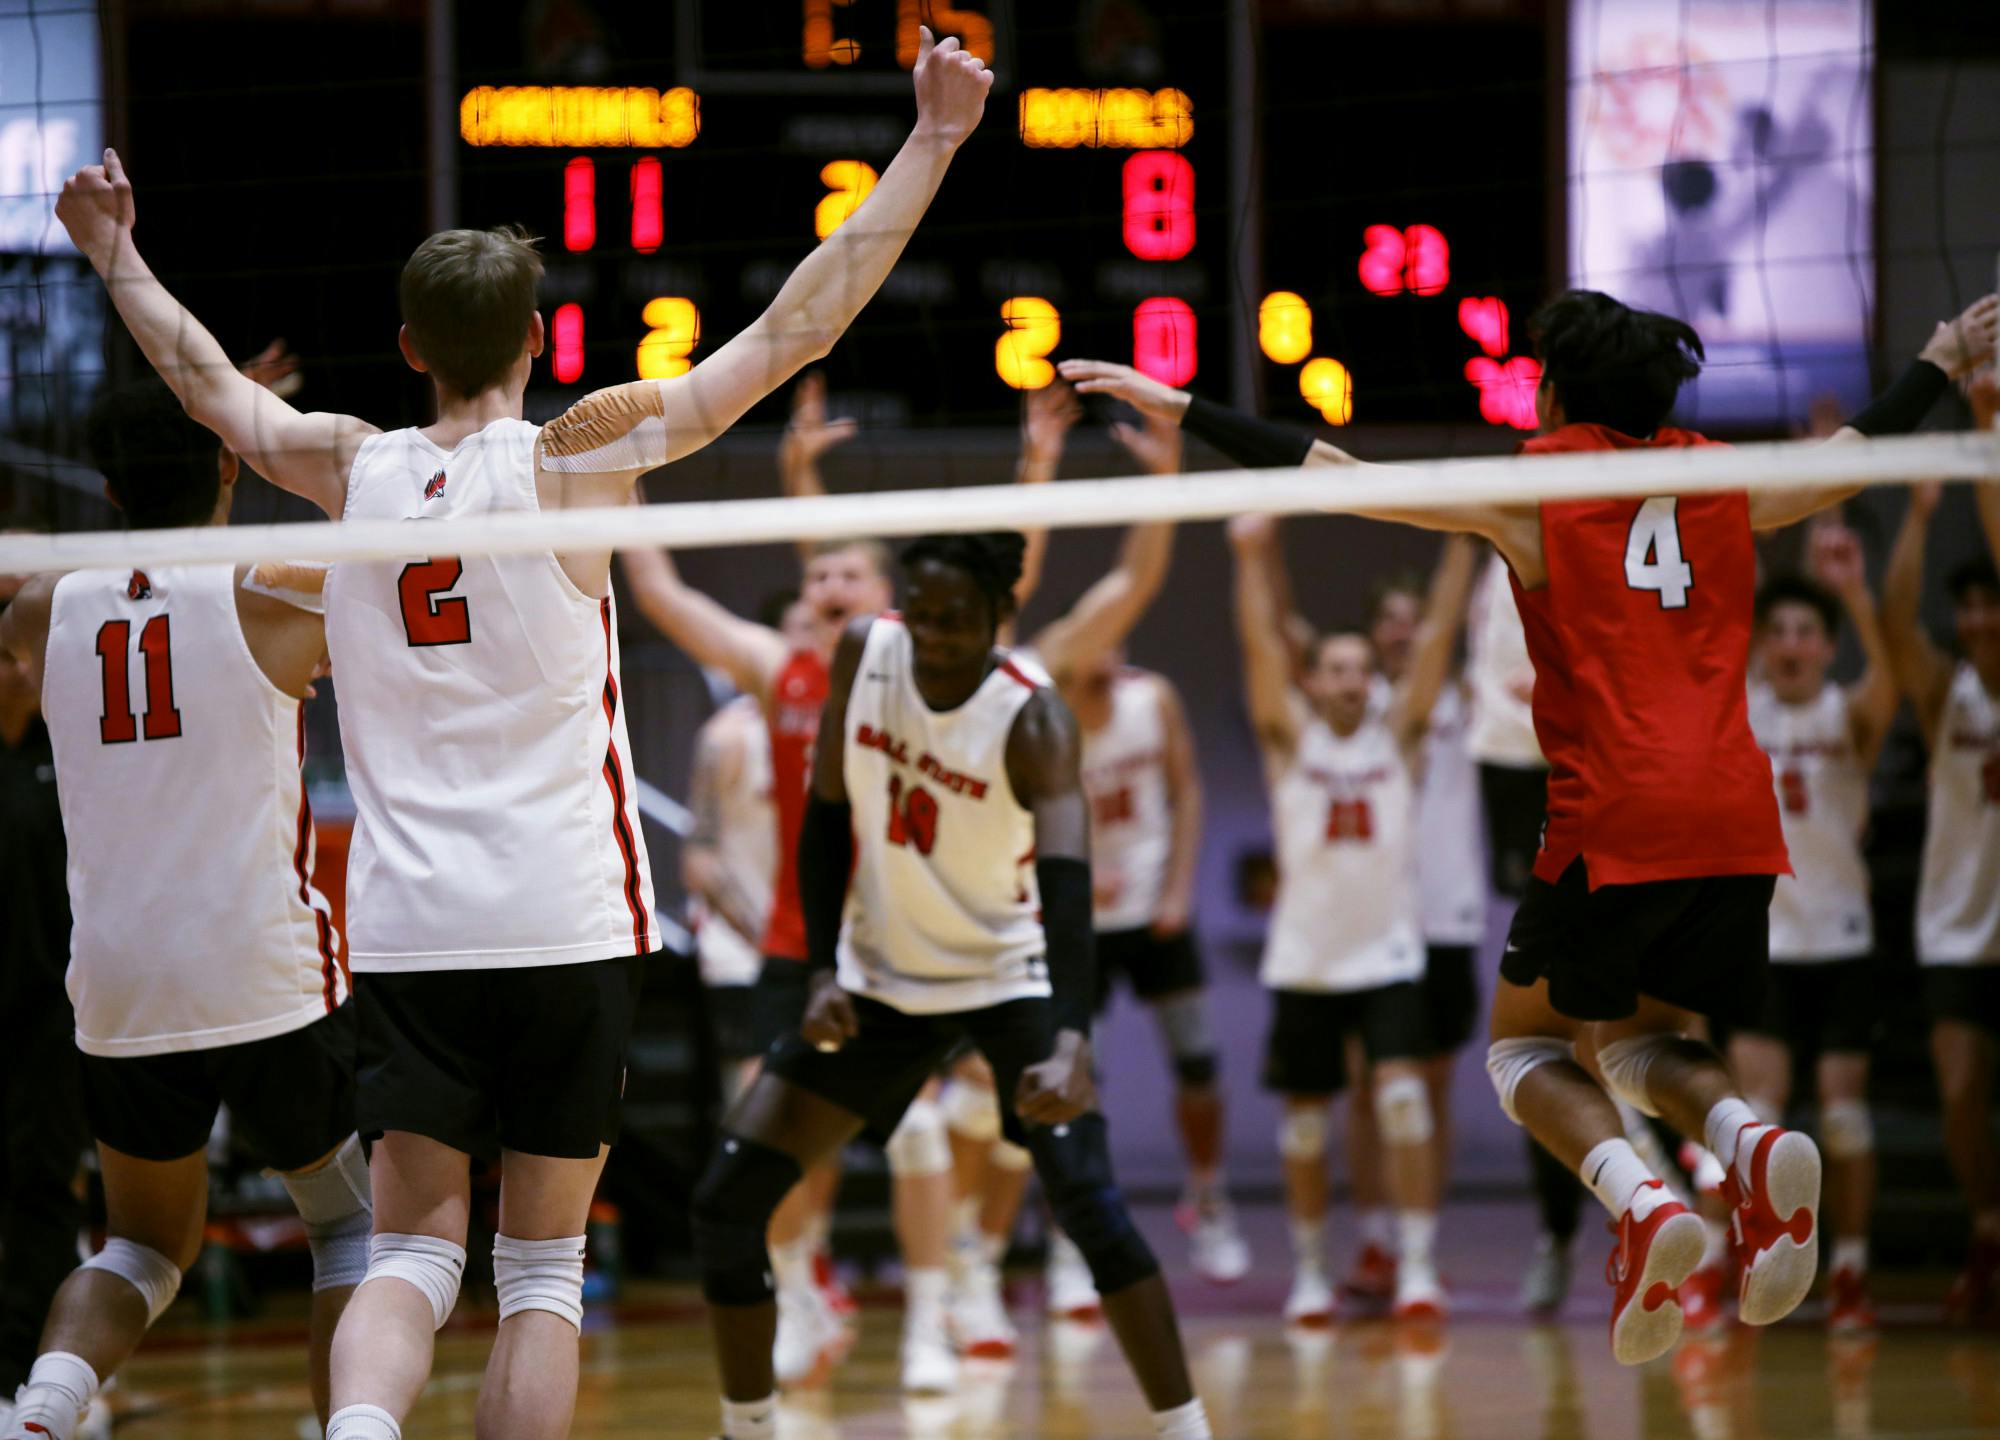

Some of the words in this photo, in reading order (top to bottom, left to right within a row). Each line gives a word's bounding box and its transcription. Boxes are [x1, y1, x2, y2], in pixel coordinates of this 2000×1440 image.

[1122, 150, 1196, 260] 8
[637, 297, 700, 380] 2
[996, 297, 1061, 390] 2
[397, 517, 472, 647] 2
[1623, 495, 1695, 610] 4
[95, 612, 182, 744] 11
